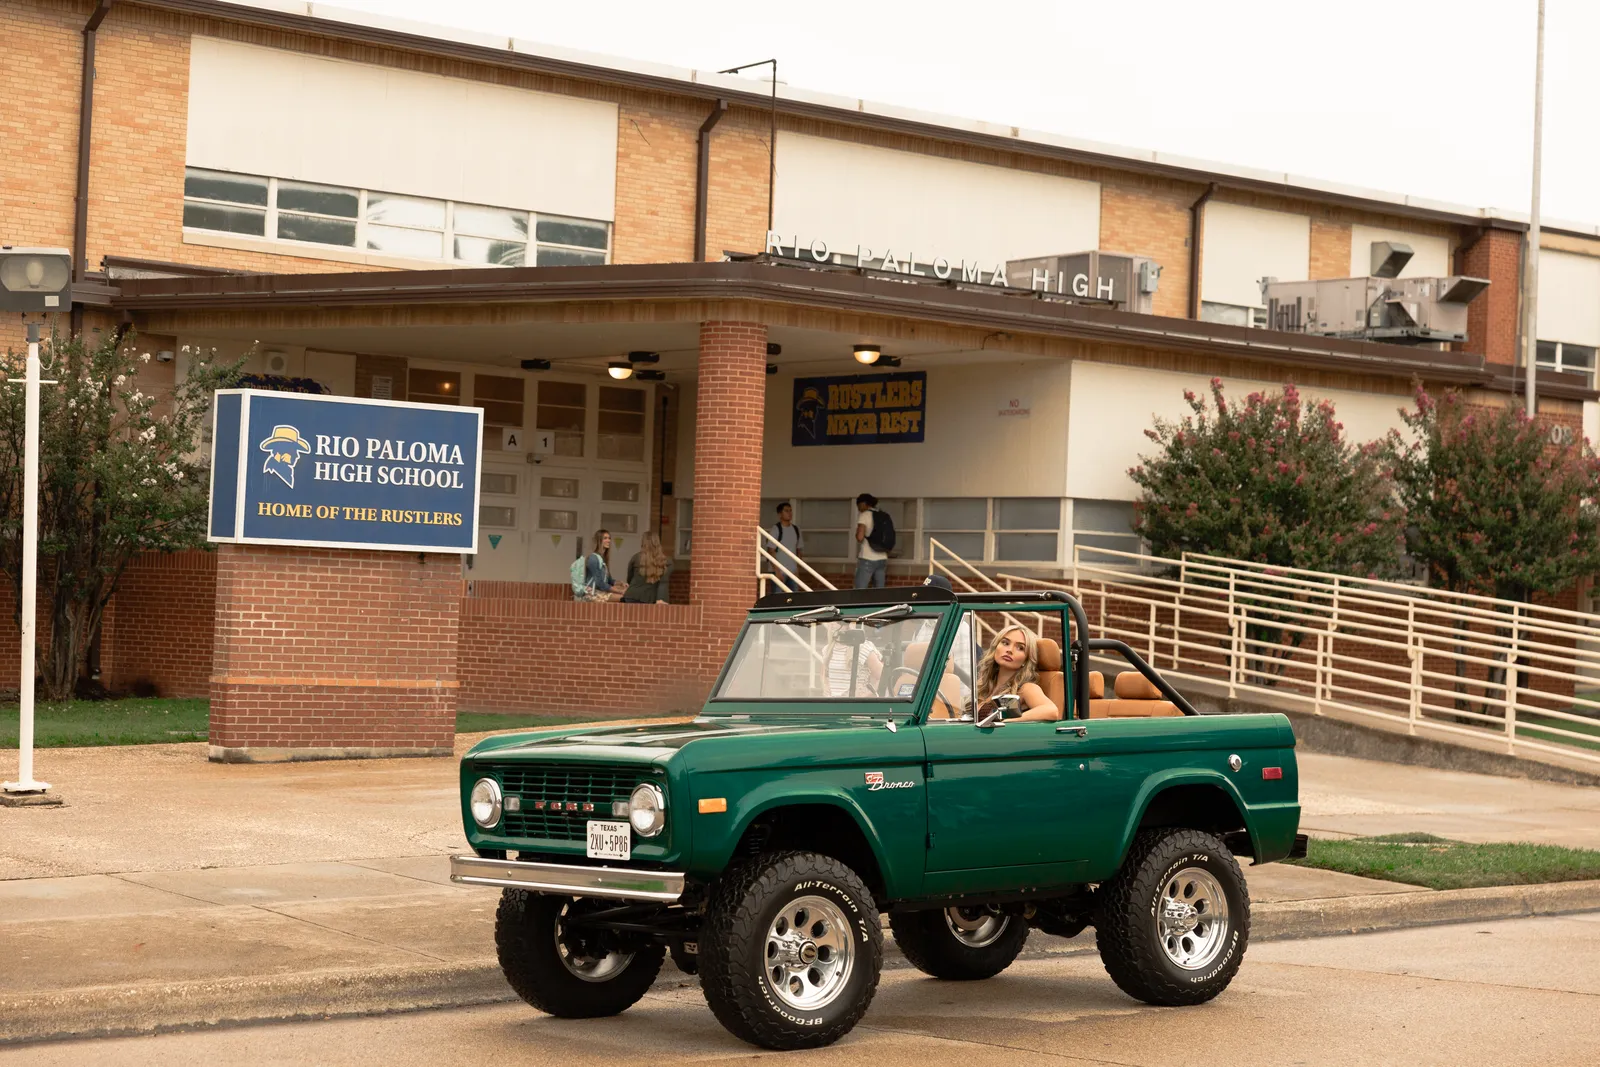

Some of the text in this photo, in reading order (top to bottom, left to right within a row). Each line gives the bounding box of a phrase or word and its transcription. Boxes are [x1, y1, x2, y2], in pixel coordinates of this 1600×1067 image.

[766, 230, 1114, 300] RIO PALOMA HIGH
[827, 380, 923, 410] RUSTLERS
[1009, 399, 1020, 408] NO
[826, 410, 921, 435] NEVER REST
[315, 434, 465, 465] RIO PALOMA
[508, 434, 548, 448] A 1
[314, 461, 464, 489] HIGH SCHOOL
[258, 502, 463, 526] HOME OF THE RUSTLERS
[868, 776, 915, 791] Bronco
[600, 824, 617, 832] TEXAS
[1151, 854, 1209, 917] All-Terrain T/A
[794, 880, 869, 942] All-Terrain T/A
[1190, 931, 1239, 983] BFGoodrich
[758, 976, 823, 1026] BFGoodrich
